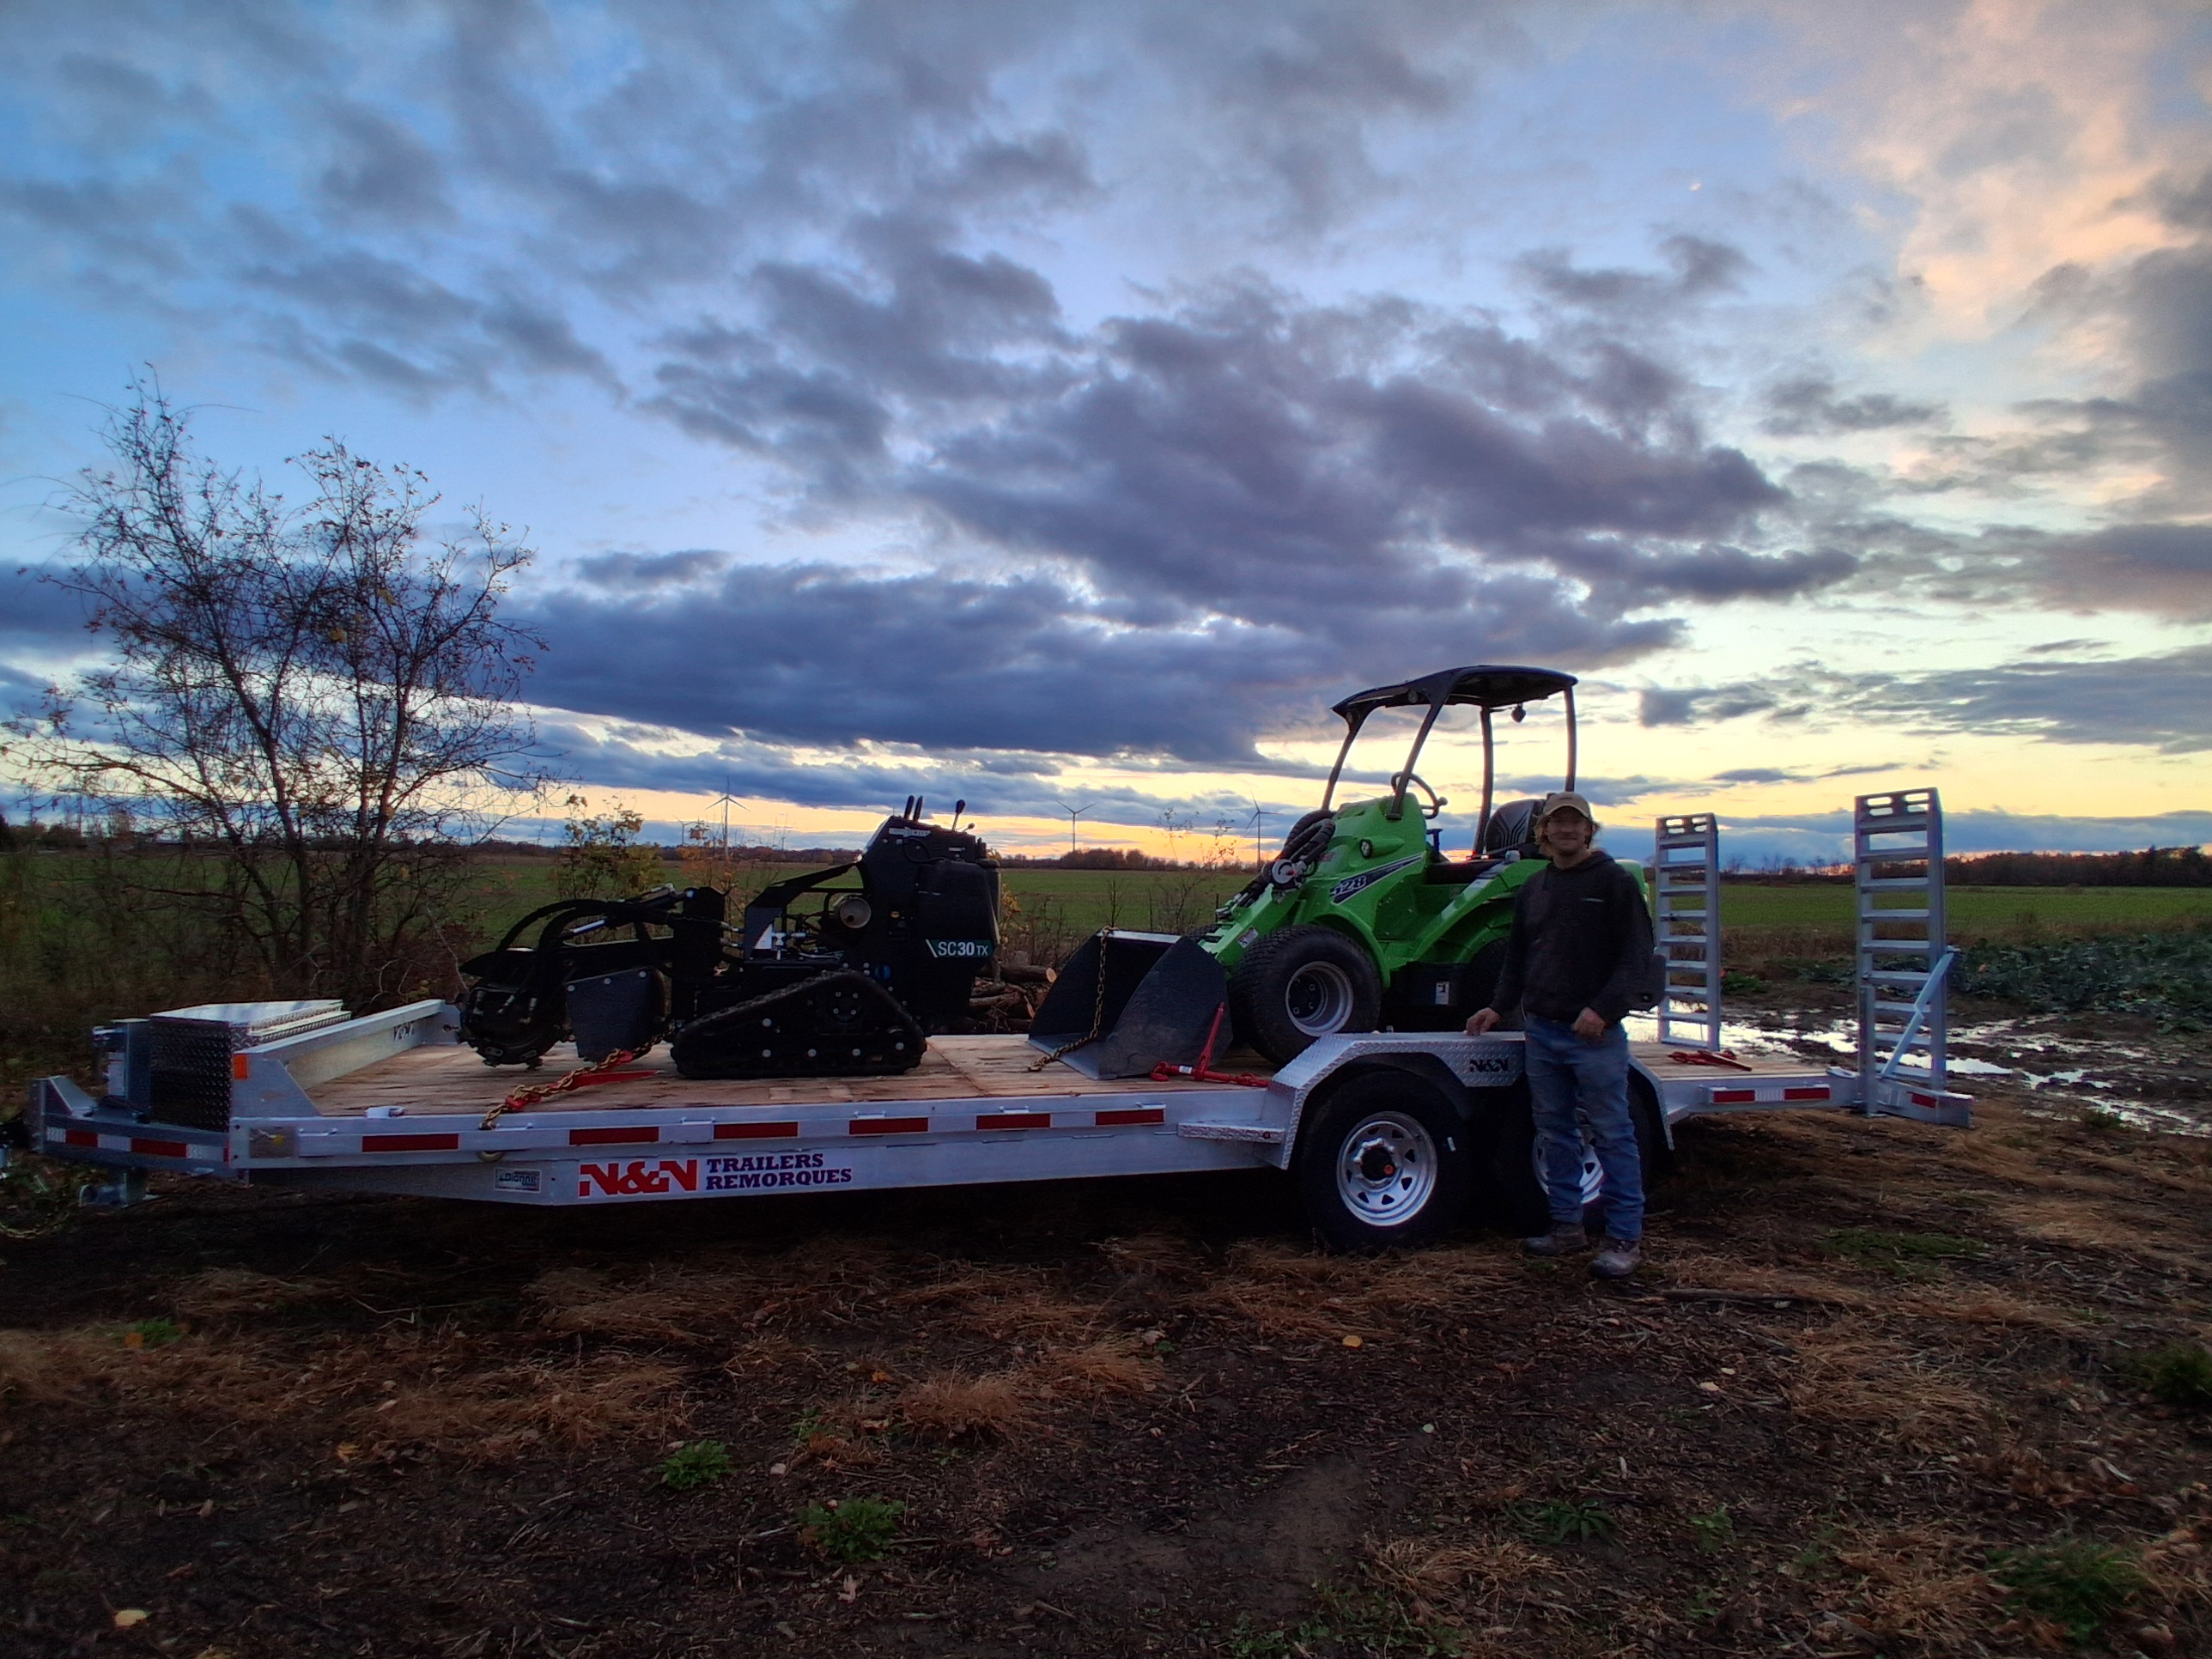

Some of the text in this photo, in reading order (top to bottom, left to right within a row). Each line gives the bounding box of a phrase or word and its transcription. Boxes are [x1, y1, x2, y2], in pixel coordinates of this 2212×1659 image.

[707, 1153, 823, 1173] TRAILERS
[579, 1159, 697, 1197] N&N
[706, 1169, 852, 1190] REMORQUES
